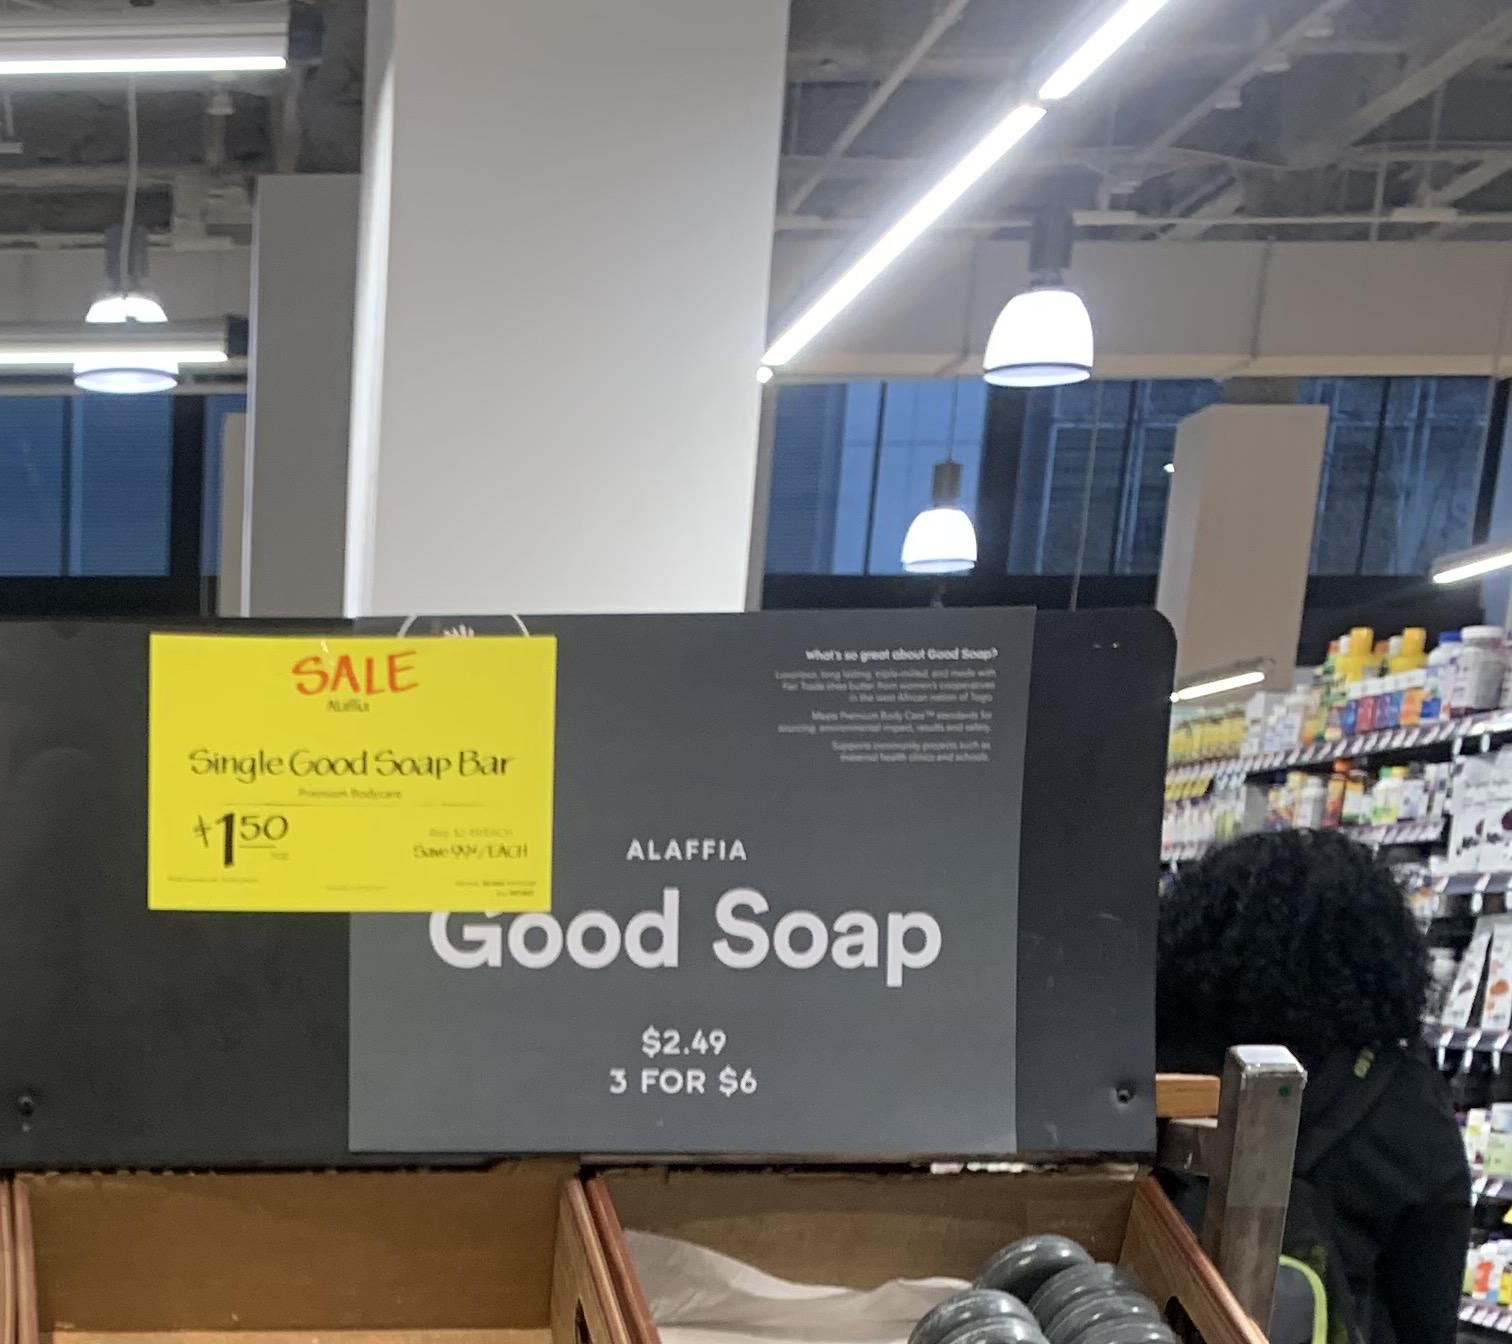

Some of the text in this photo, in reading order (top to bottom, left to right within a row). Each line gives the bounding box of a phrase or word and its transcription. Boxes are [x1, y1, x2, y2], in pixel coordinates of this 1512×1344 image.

[927, 647, 960, 660] Good
[291, 650, 420, 697] SALE
[188, 748, 513, 785] Single Good Soap Bar
[625, 838, 748, 861] ALAFFIA
[429, 886, 945, 988] Good Soap
[640, 1026, 727, 1057] $2.49
[609, 1066, 757, 1097] 3 FOR $6
